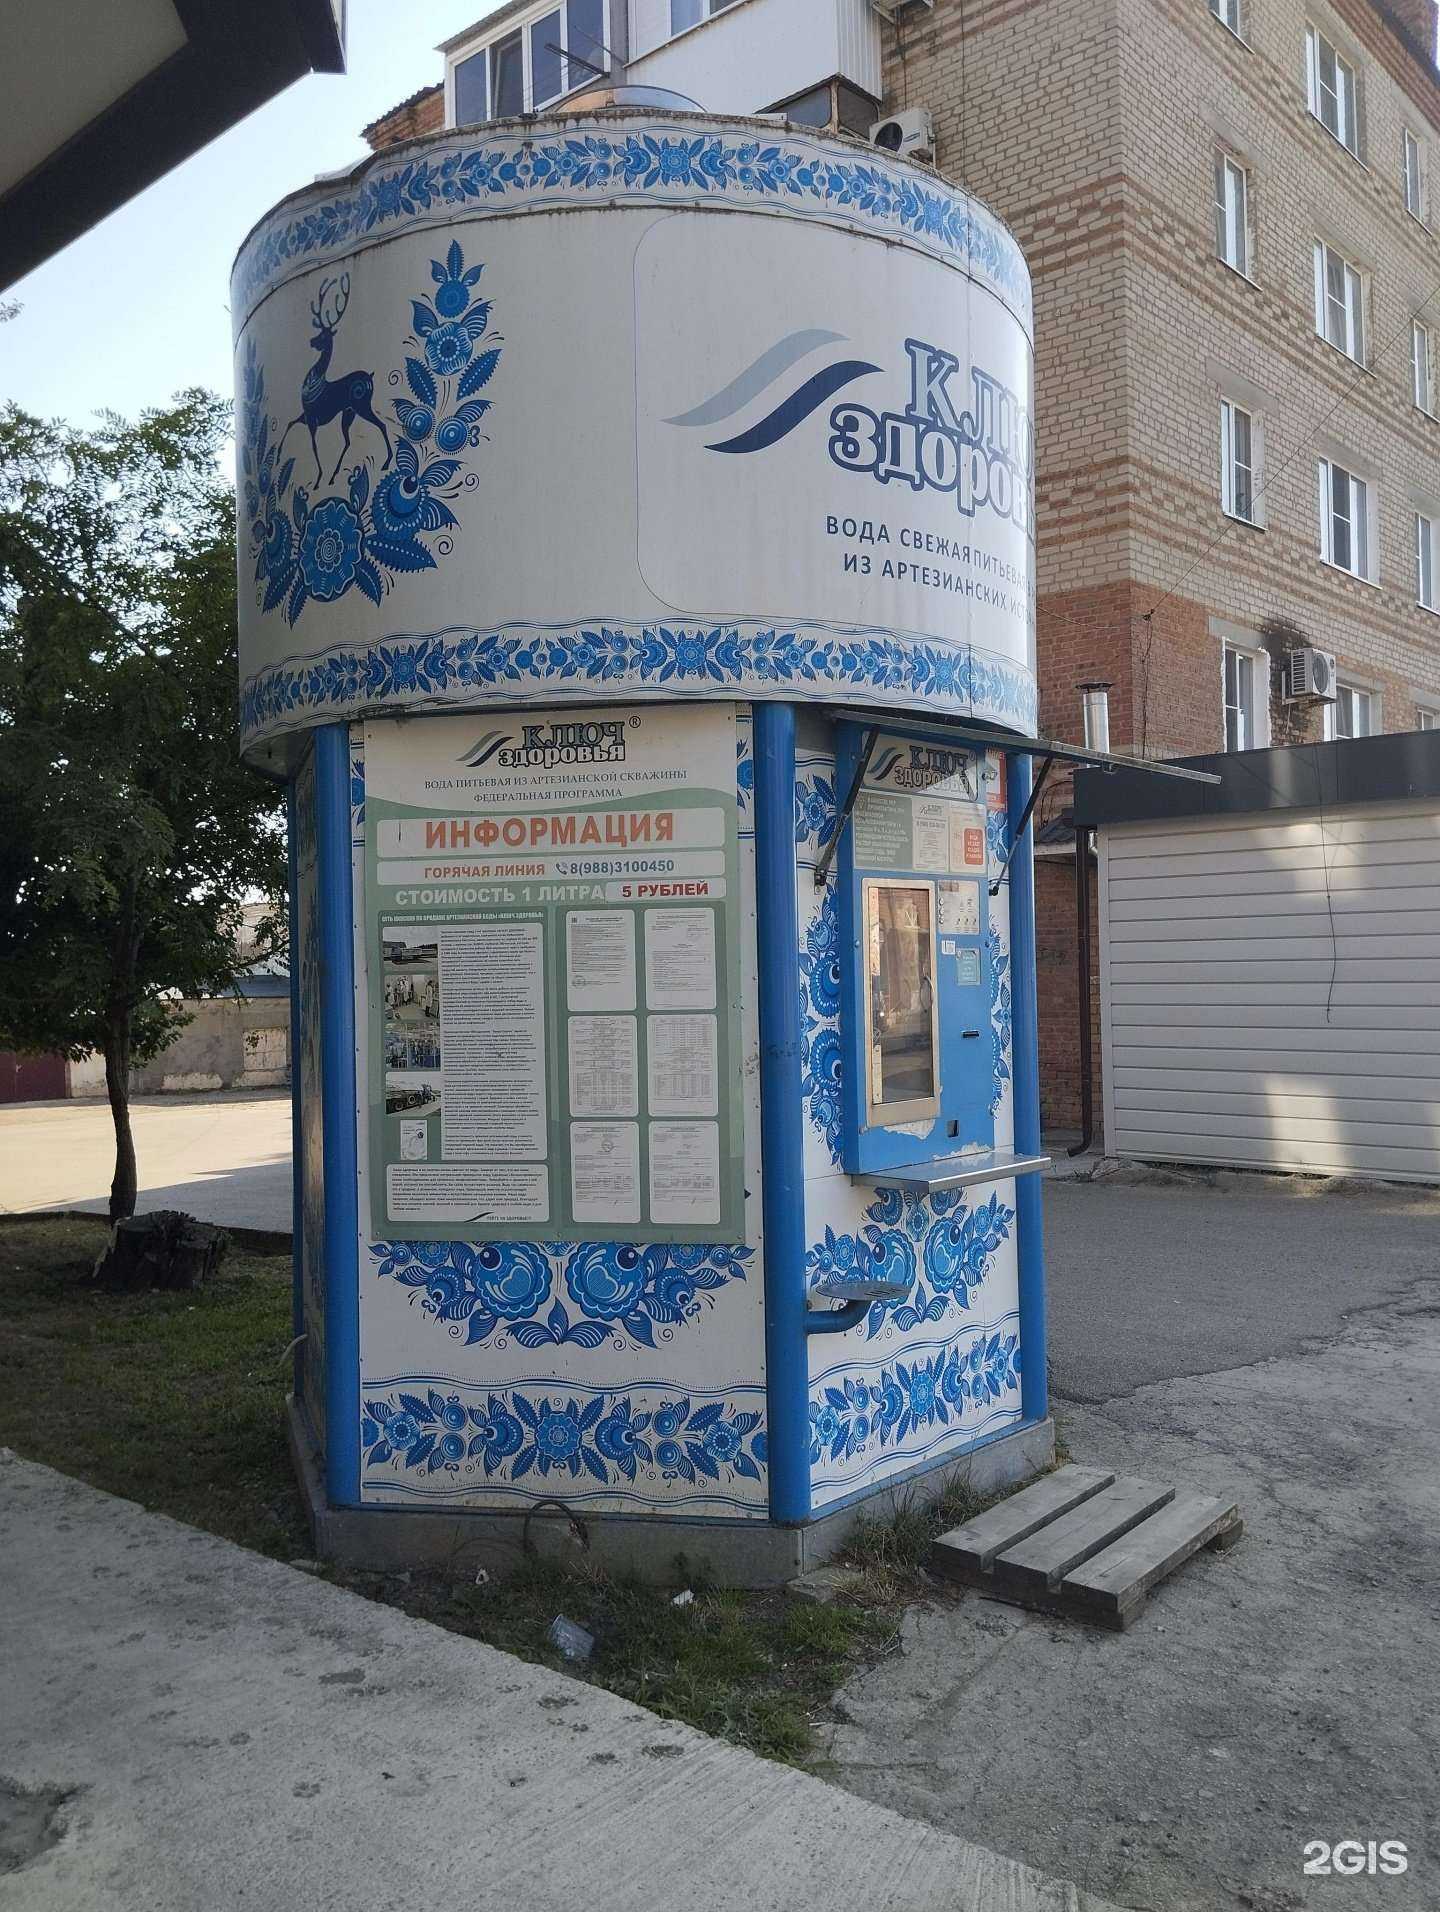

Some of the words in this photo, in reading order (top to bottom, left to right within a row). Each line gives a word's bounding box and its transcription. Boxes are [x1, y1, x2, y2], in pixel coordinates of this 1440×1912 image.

[826, 515, 890, 545] ВОДА
[900, 528, 970, 564] СВЕЖАЯ
[844, 553, 872, 575] ИЗ
[881, 559, 1007, 611] АРТЕЗИАНСКИХ
[425, 780, 453, 789] ВОДА
[456, 777, 511, 788] ПИТЬЕВАЯ
[514, 776, 528, 785] ИЗ
[530, 772, 617, 785] АРТЕЗИАНСКОЙ
[620, 770, 687, 781] СКВАЖИНЫ
[473, 791, 551, 802] ФЕДЕРАЛЬНАЯ
[554, 788, 623, 799] ПРОГРАММА
[425, 812, 673, 849] ИНФОРМАЦИЯ
[424, 866, 490, 879] ГОРЯЧАЯ
[494, 864, 545, 876] ЛИНИЯ
[570, 860, 675, 876] 8(988)3100450
[395, 887, 516, 906] СТОИМОСТЬ
[522, 887, 531, 901] 1
[537, 884, 605, 901] ЛИТРА
[622, 885, 632, 898] 5
[637, 880, 709, 897] РУБЛЕЙ
